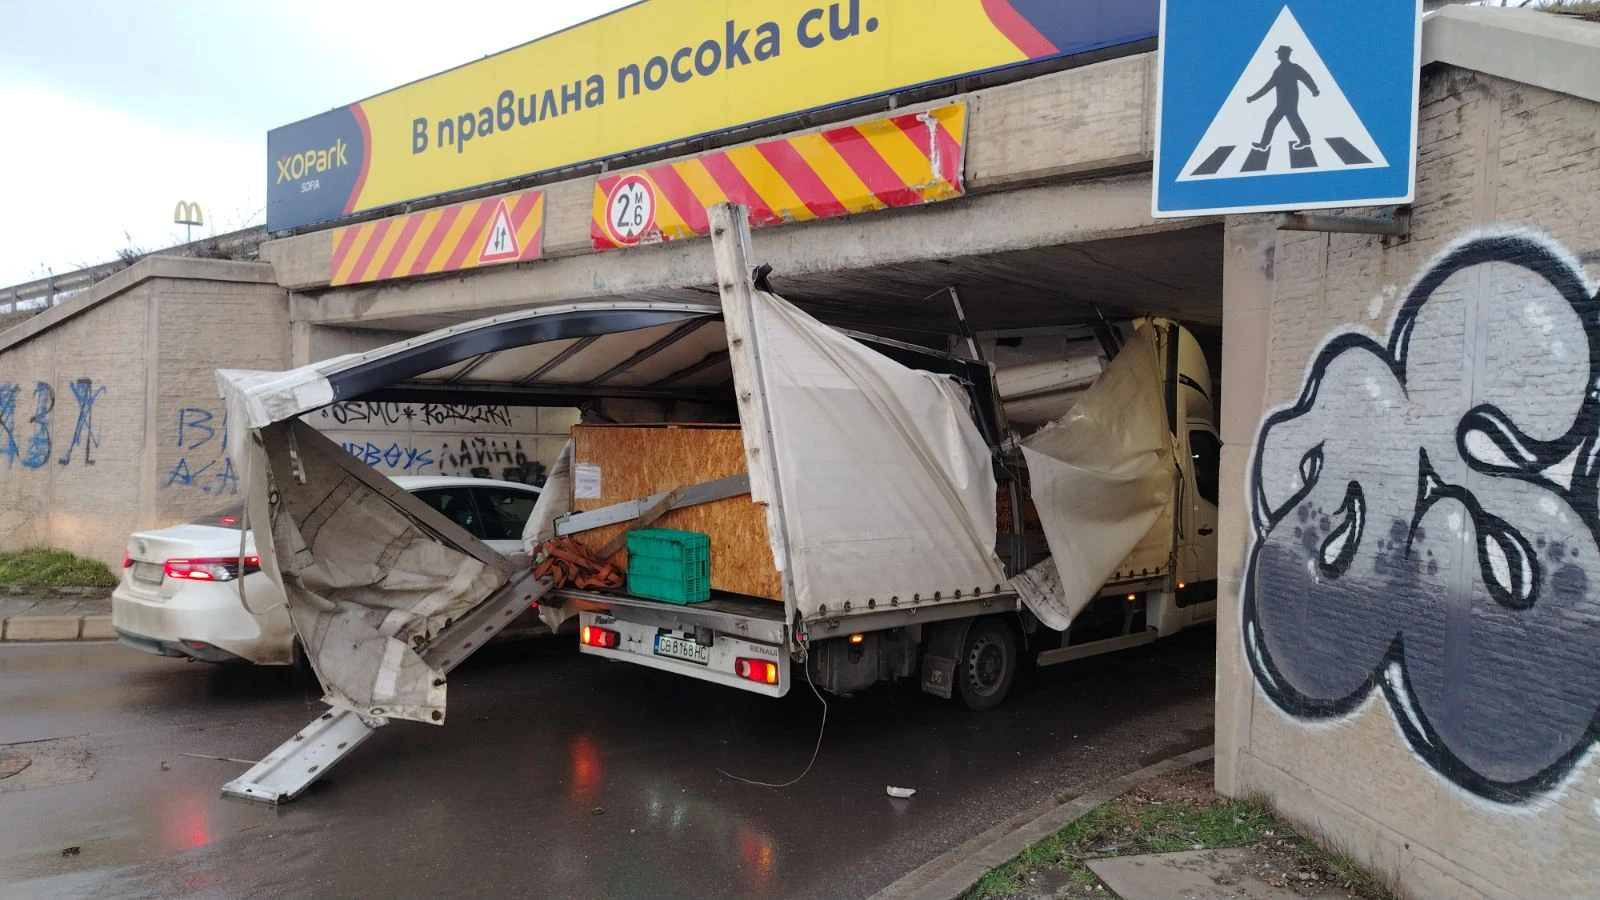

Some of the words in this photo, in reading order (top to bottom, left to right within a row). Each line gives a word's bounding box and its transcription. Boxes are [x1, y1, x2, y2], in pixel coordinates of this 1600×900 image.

[412, 117, 429, 154] В
[437, 75, 605, 153] правилна
[617, 20, 781, 99] посока
[797, 0, 879, 48] си.
[301, 179, 320, 193] SOFIA
